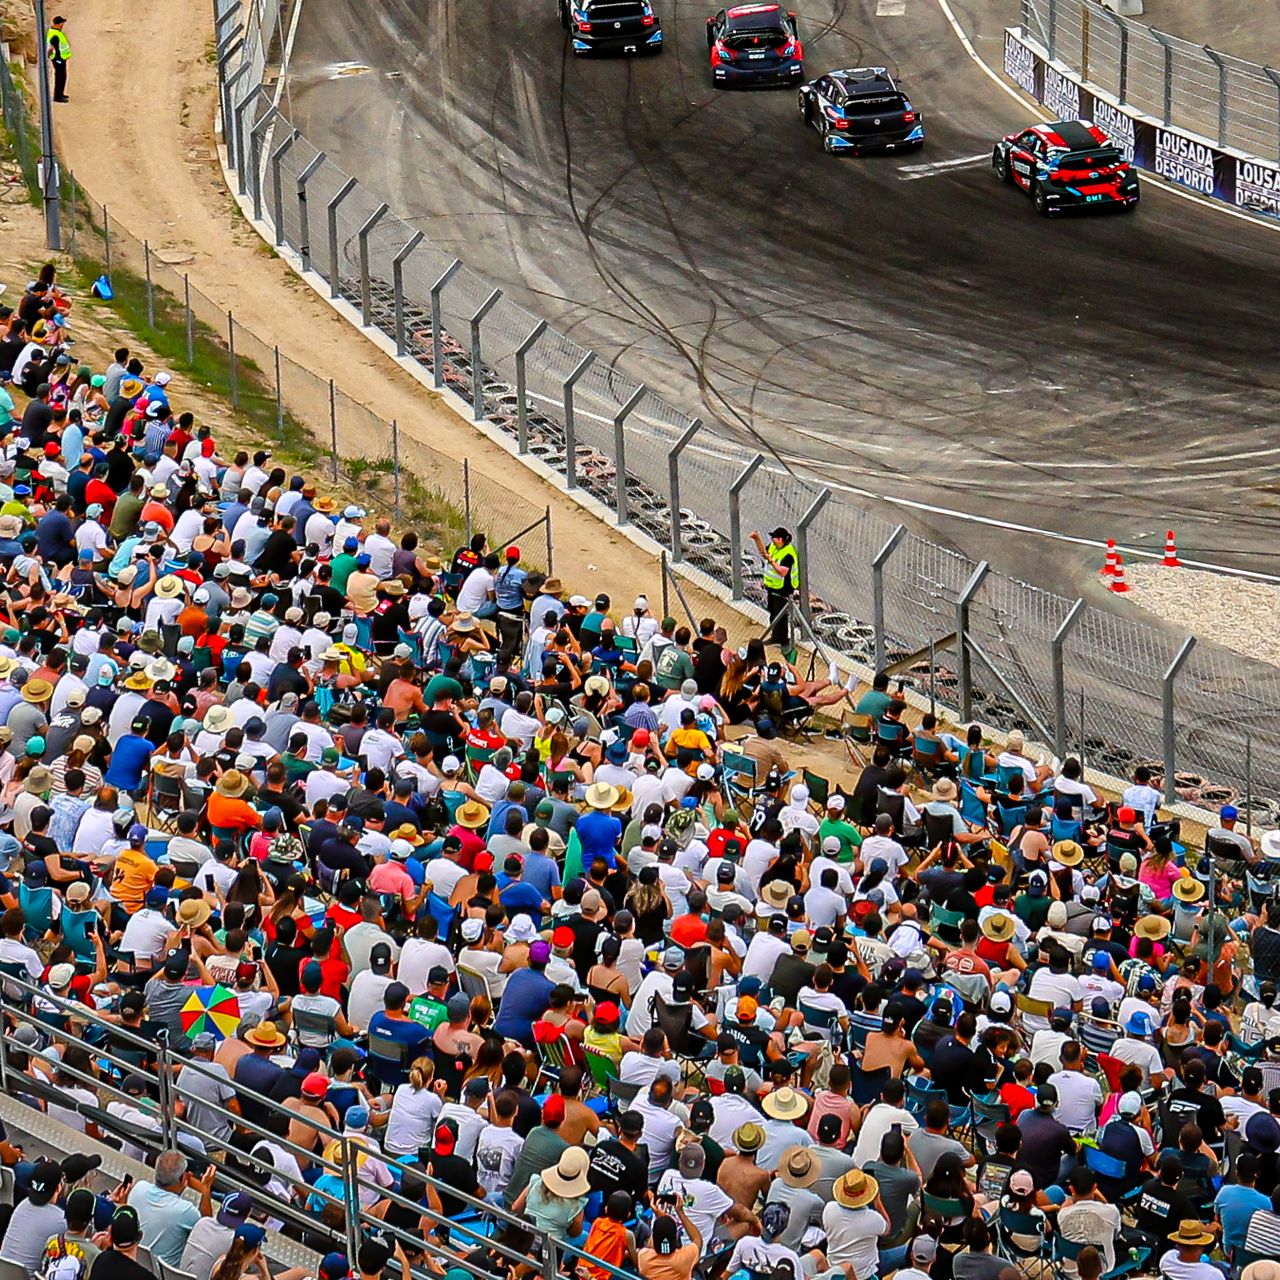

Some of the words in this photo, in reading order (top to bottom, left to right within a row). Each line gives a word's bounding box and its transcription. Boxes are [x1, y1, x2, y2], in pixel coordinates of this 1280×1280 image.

[1004, 32, 1034, 68] LOUSADA
[1044, 63, 1080, 105] LOUSADA
[1092, 96, 1135, 140] LOUSADA
[1155, 128, 1214, 170] LOUSADA
[1155, 155, 1214, 195] DESPORTO
